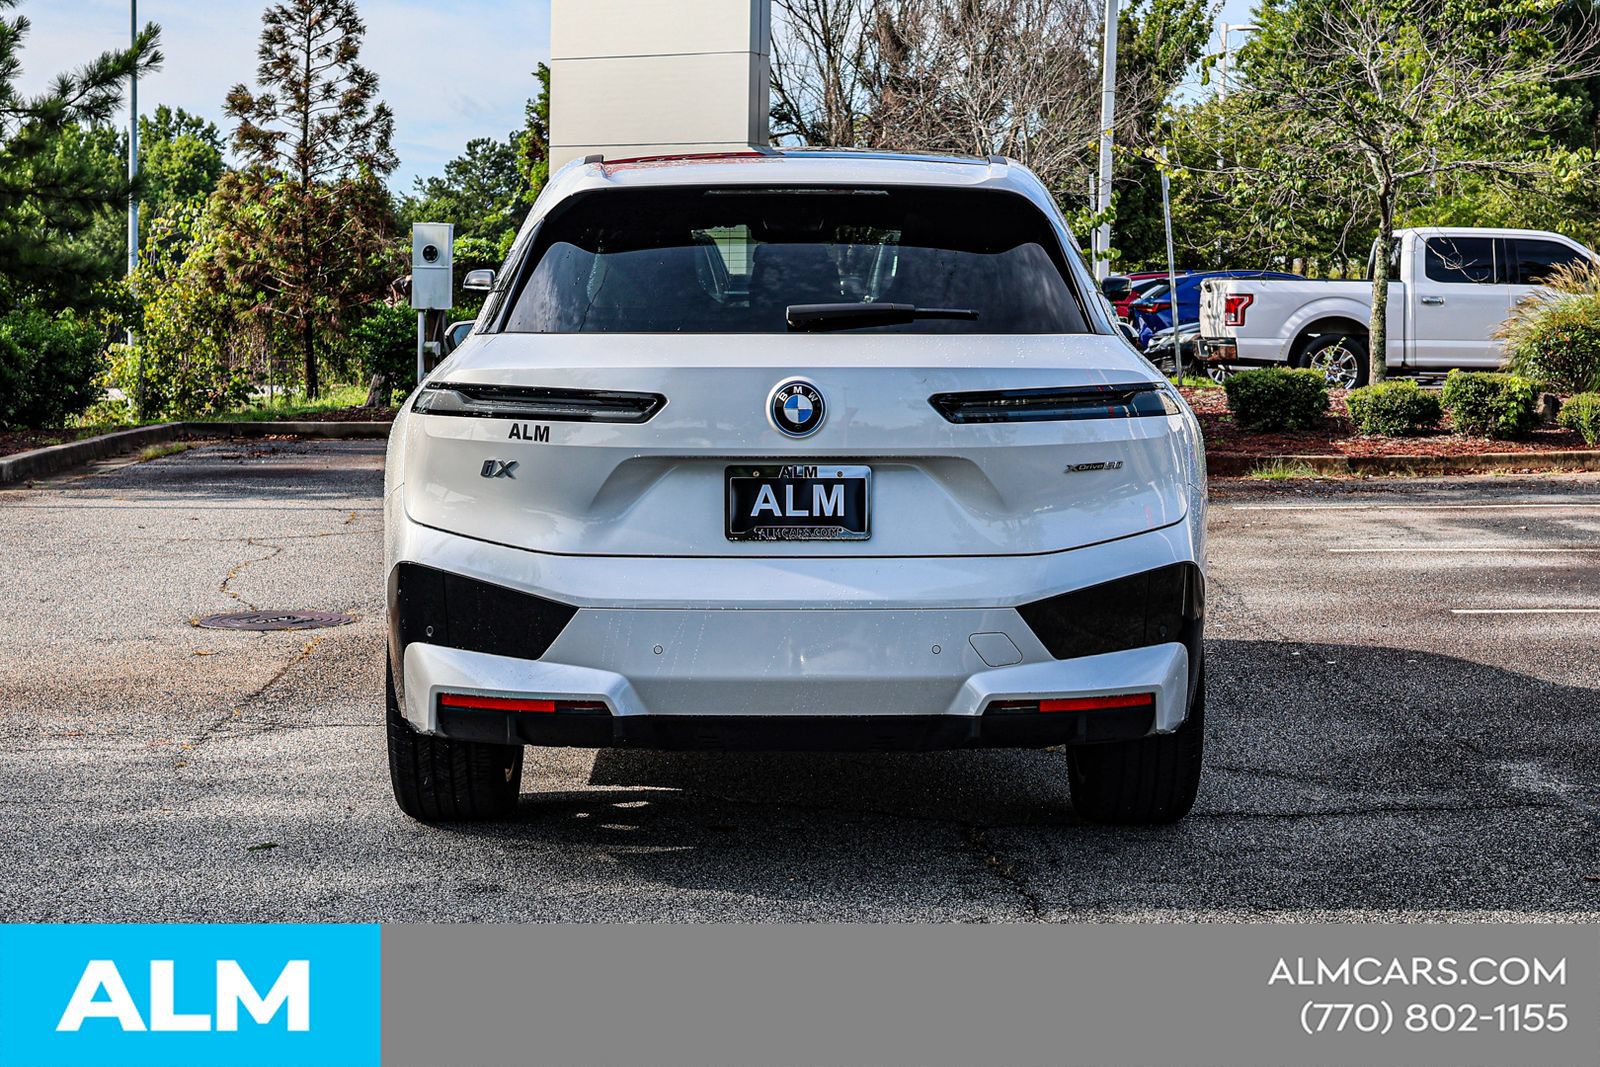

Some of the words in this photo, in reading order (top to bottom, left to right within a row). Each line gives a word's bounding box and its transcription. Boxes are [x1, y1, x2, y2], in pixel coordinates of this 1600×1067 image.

[778, 386, 819, 402] BMW
[508, 423, 550, 443] ALM
[778, 465, 818, 479] ALM
[751, 485, 845, 517] ALM
